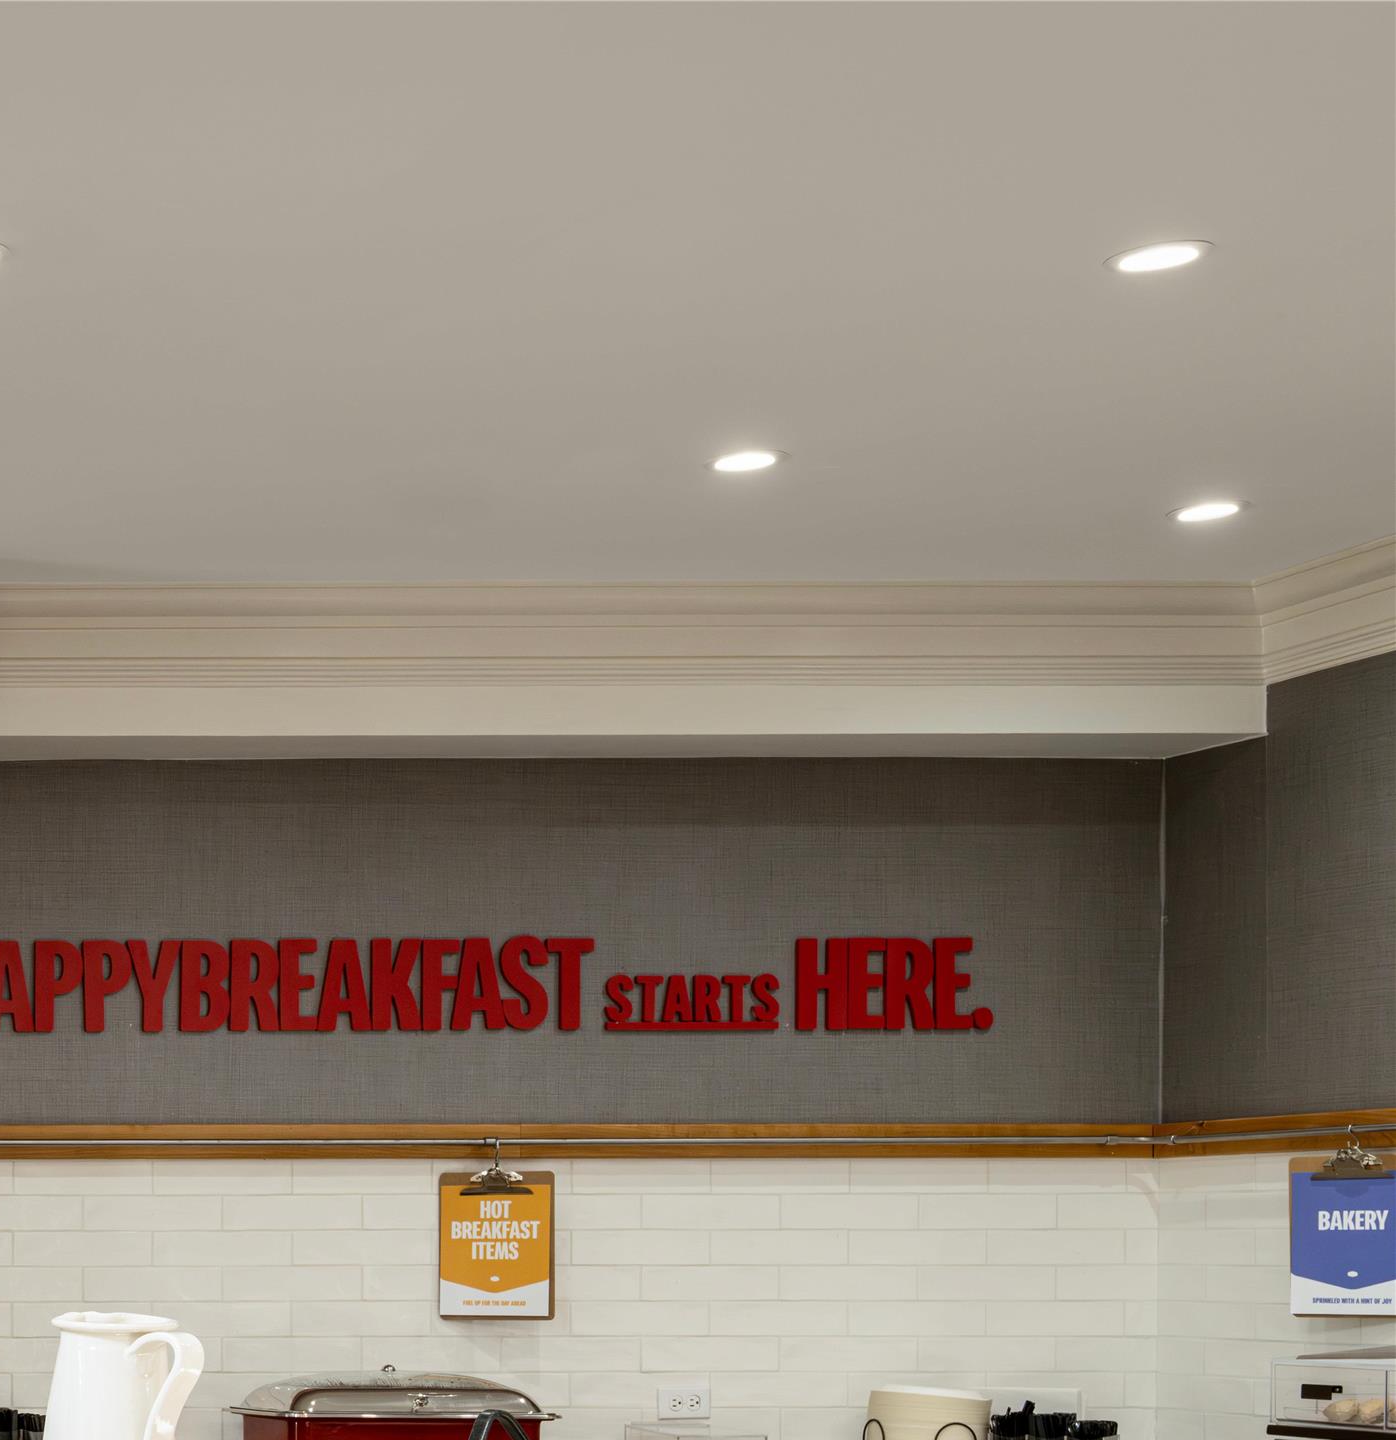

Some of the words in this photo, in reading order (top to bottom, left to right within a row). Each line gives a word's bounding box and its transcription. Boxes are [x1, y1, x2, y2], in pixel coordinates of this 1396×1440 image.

[603, 973, 780, 1031] STARTS
[795, 937, 994, 1031] HERE.
[479, 1200, 512, 1219] HOT
[450, 1221, 541, 1239] BREAKFAST
[1318, 1210, 1389, 1231] BAKERY
[471, 1241, 519, 1260] ITEMS
